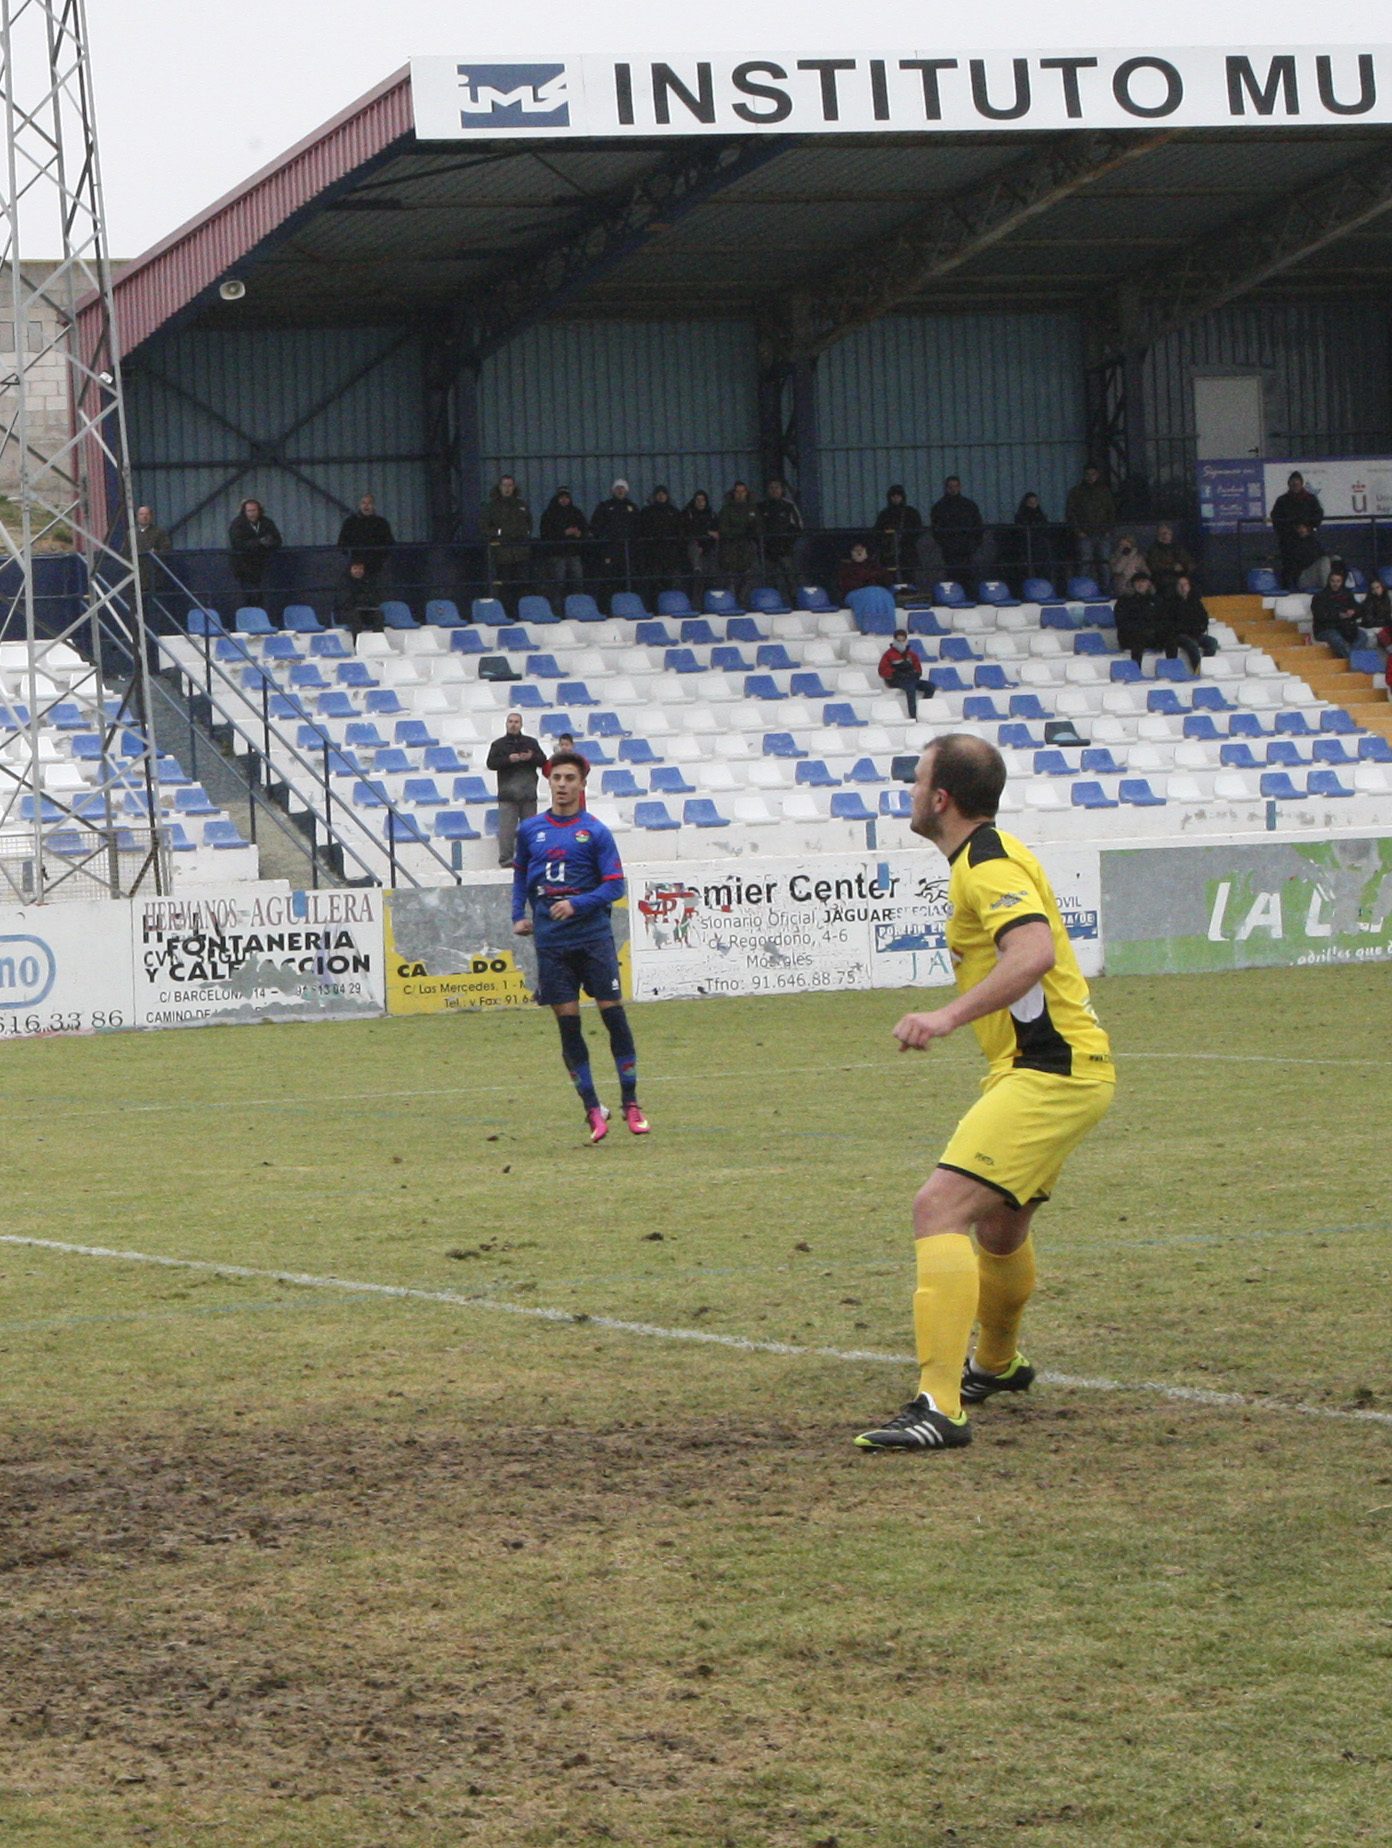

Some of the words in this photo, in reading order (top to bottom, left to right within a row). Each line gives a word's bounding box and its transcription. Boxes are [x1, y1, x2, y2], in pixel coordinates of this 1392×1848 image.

[615, 56, 1184, 125] INSTITUTO
[1226, 54, 1376, 117] MU
[790, 872, 900, 902] Center
[824, 908, 893, 923] JAGUAR
[166, 930, 354, 957] FONTANERIA
[823, 929, 848, 943] 4-6
[145, 968, 159, 983] Y
[349, 982, 361, 994] 29
[419, 984, 436, 994] Las
[91, 1009, 124, 1029] 86
[146, 1010, 193, 1023] CAMINO
